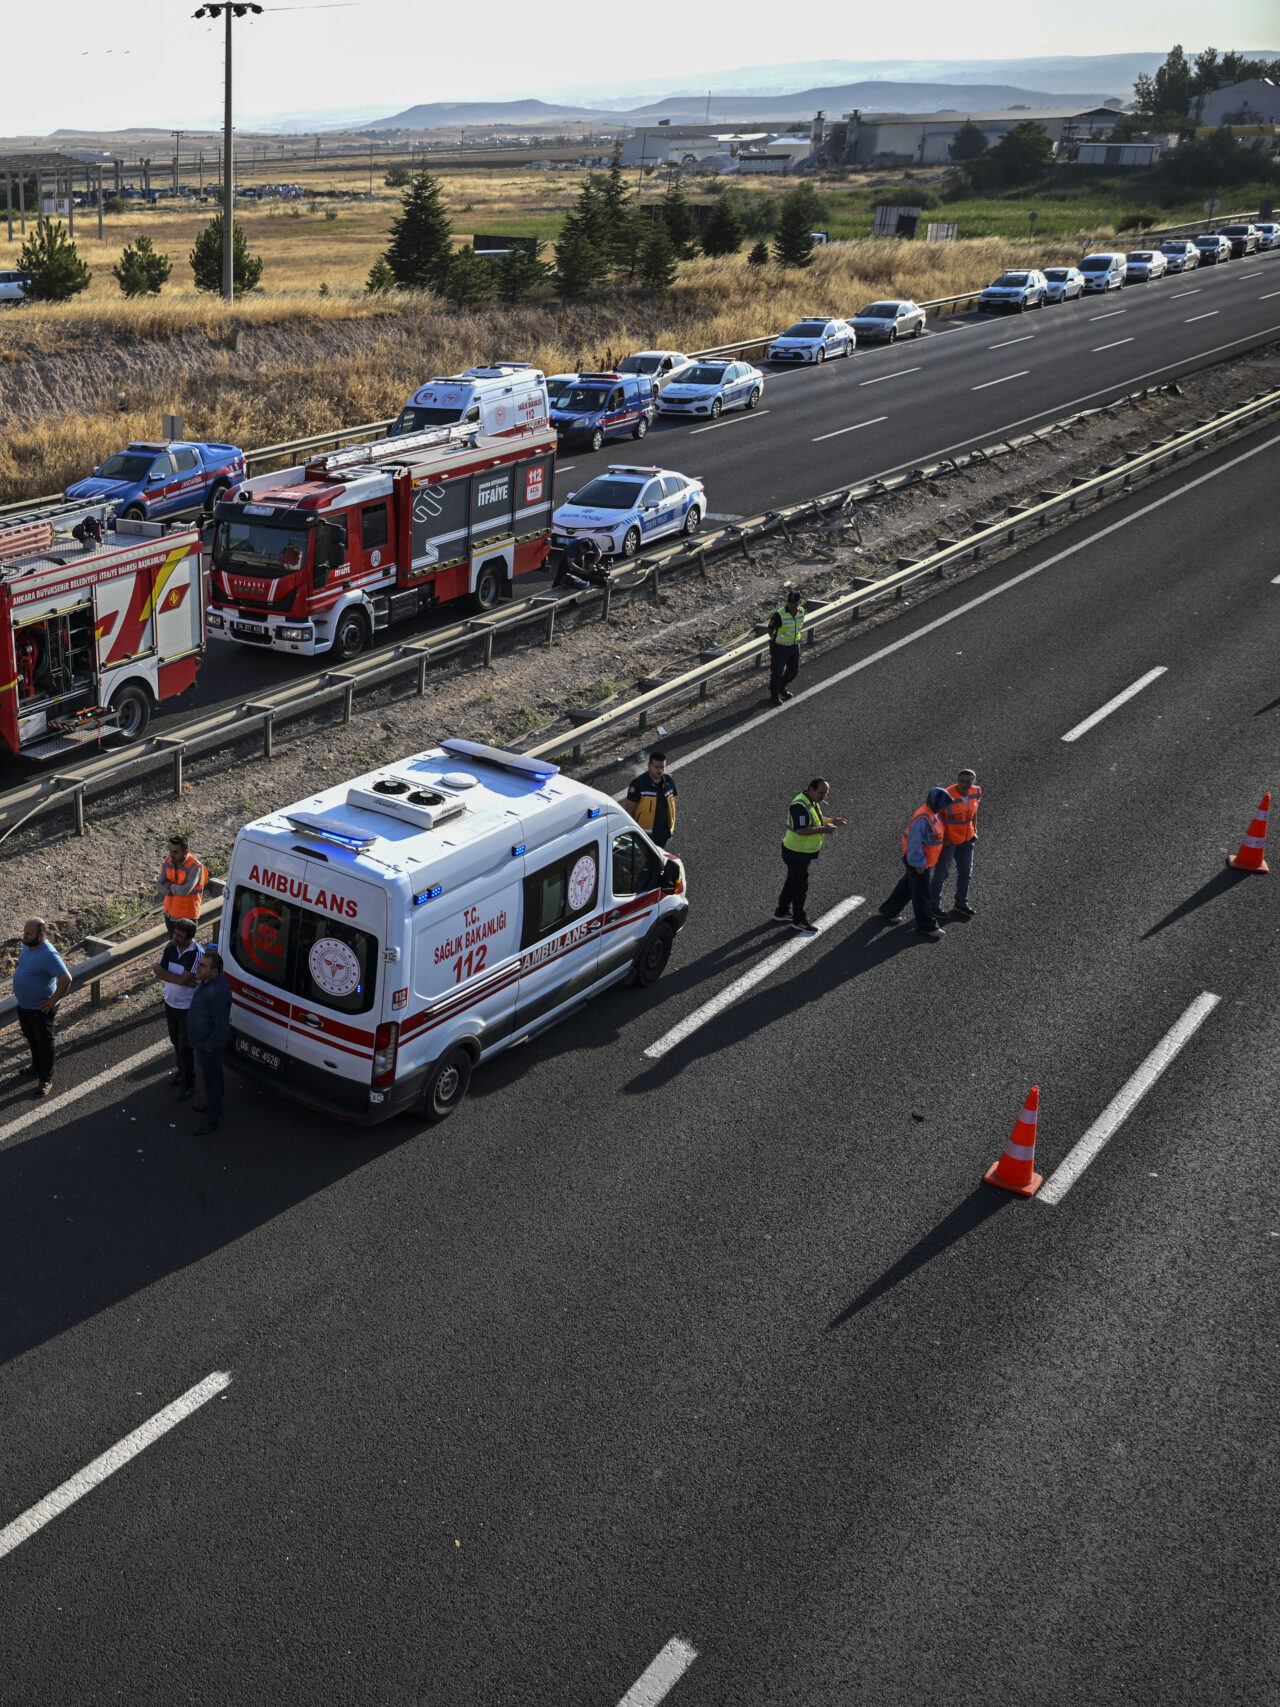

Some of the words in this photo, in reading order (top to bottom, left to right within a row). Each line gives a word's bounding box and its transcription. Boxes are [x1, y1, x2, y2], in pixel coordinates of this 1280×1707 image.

[526, 409, 534, 420] 112
[180, 476, 202, 488] JANDARMA
[528, 469, 542, 484] 112
[478, 484, 508, 507] İTFAİYE
[12, 591, 36, 606] ANKARA
[99, 568, 118, 583] İTFAİYE
[248, 864, 359, 919] AMBULANS
[463, 906, 480, 928] T.C.
[434, 934, 463, 965] SAĞLIK
[464, 910, 508, 951] BAKANLIĞI
[522, 922, 588, 971] AMBULANS
[452, 944, 489, 984] 112
[395, 990, 406, 1003] 112
